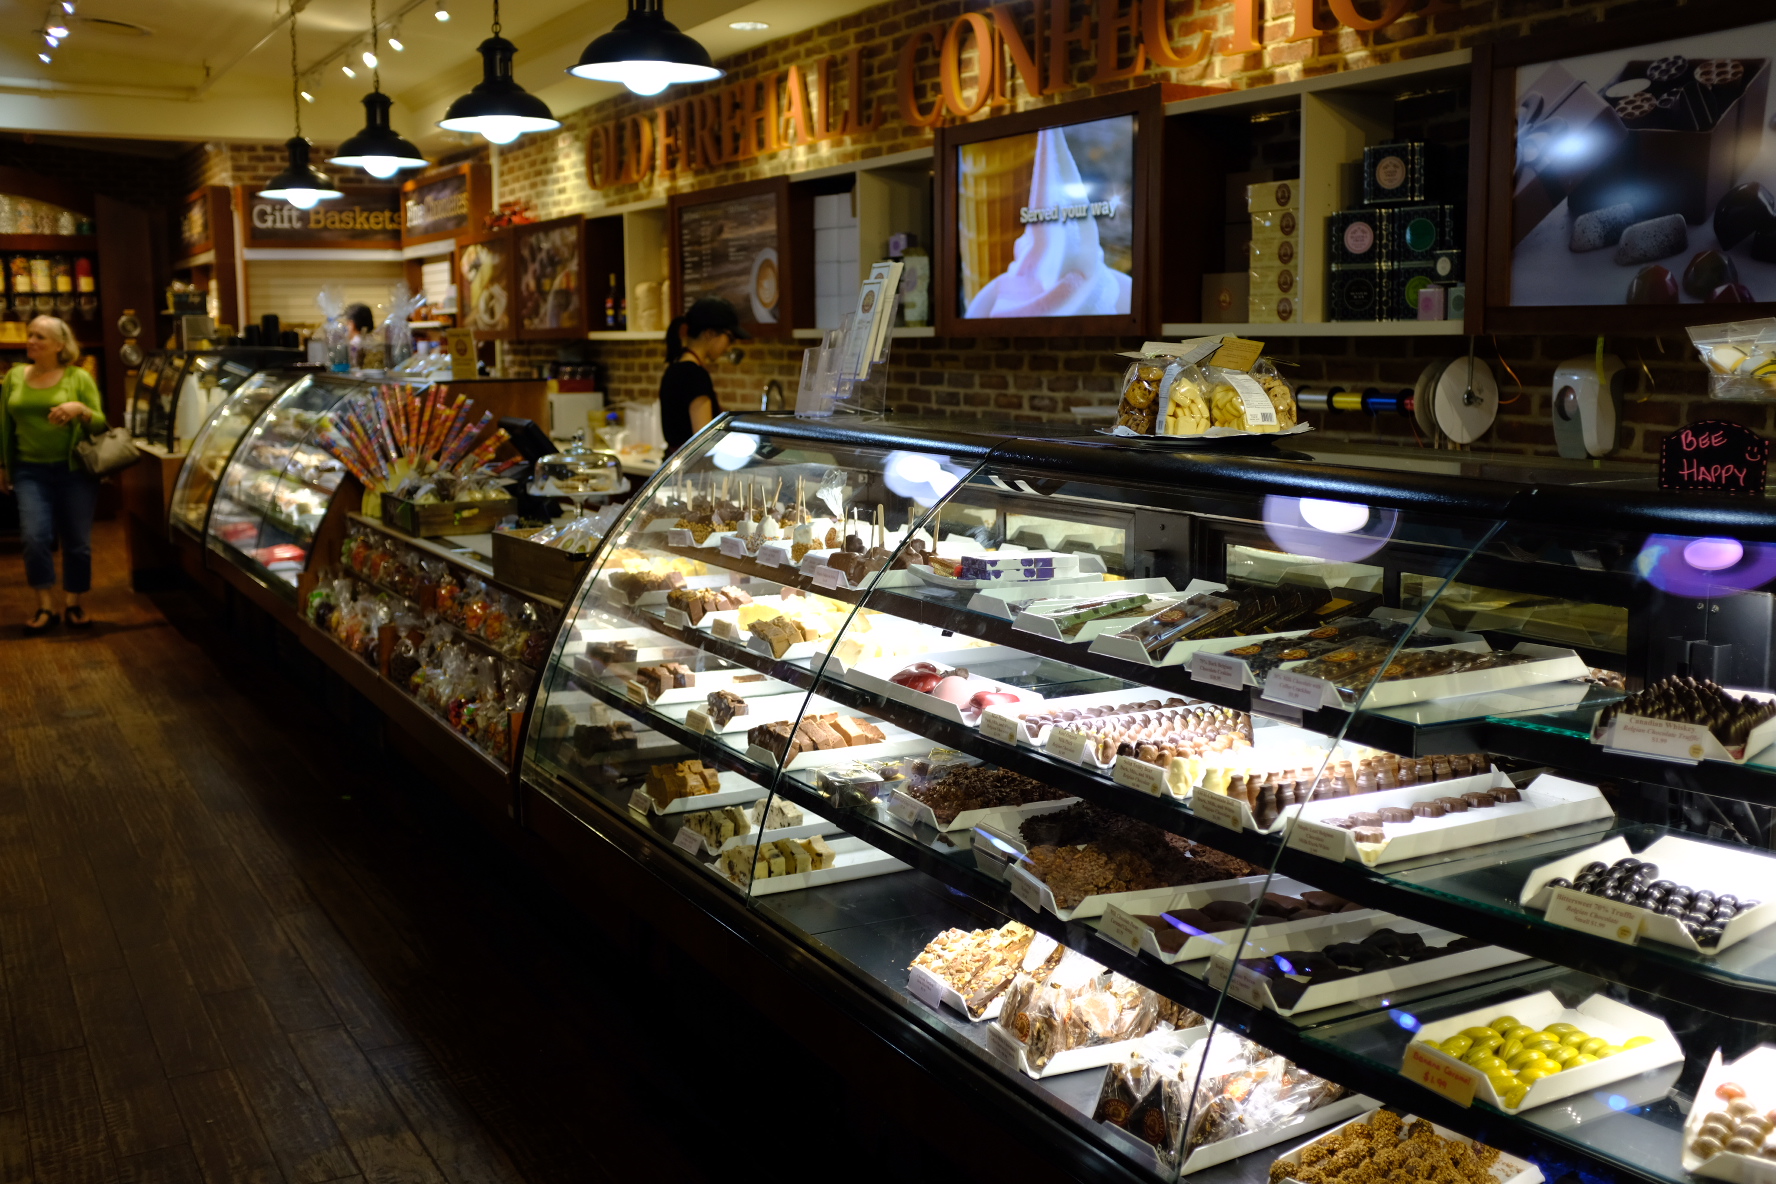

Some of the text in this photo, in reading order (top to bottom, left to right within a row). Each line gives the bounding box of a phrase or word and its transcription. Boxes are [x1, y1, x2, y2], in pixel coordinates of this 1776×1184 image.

[586, 116, 653, 190] OLD
[656, 44, 882, 178] FIREHALL
[252, 204, 401, 230] Gift Baskets
[1019, 200, 1117, 224] Served your way
[1681, 429, 1728, 451] BEE
[1678, 458, 1747, 487] HAPPY
[1623, 724, 1701, 742] Belgian Chocolate Truffle
[1629, 717, 1696, 734] Canadian Whiskey
[1557, 893, 1636, 920] Bittersweet 70% Truffle
[1566, 905, 1620, 925] Belgian Chocolate
[1574, 916, 1606, 929] Small $1.99
[1413, 1051, 1472, 1085] Banana Caramel
[1423, 1071, 1448, 1089] $1.99
